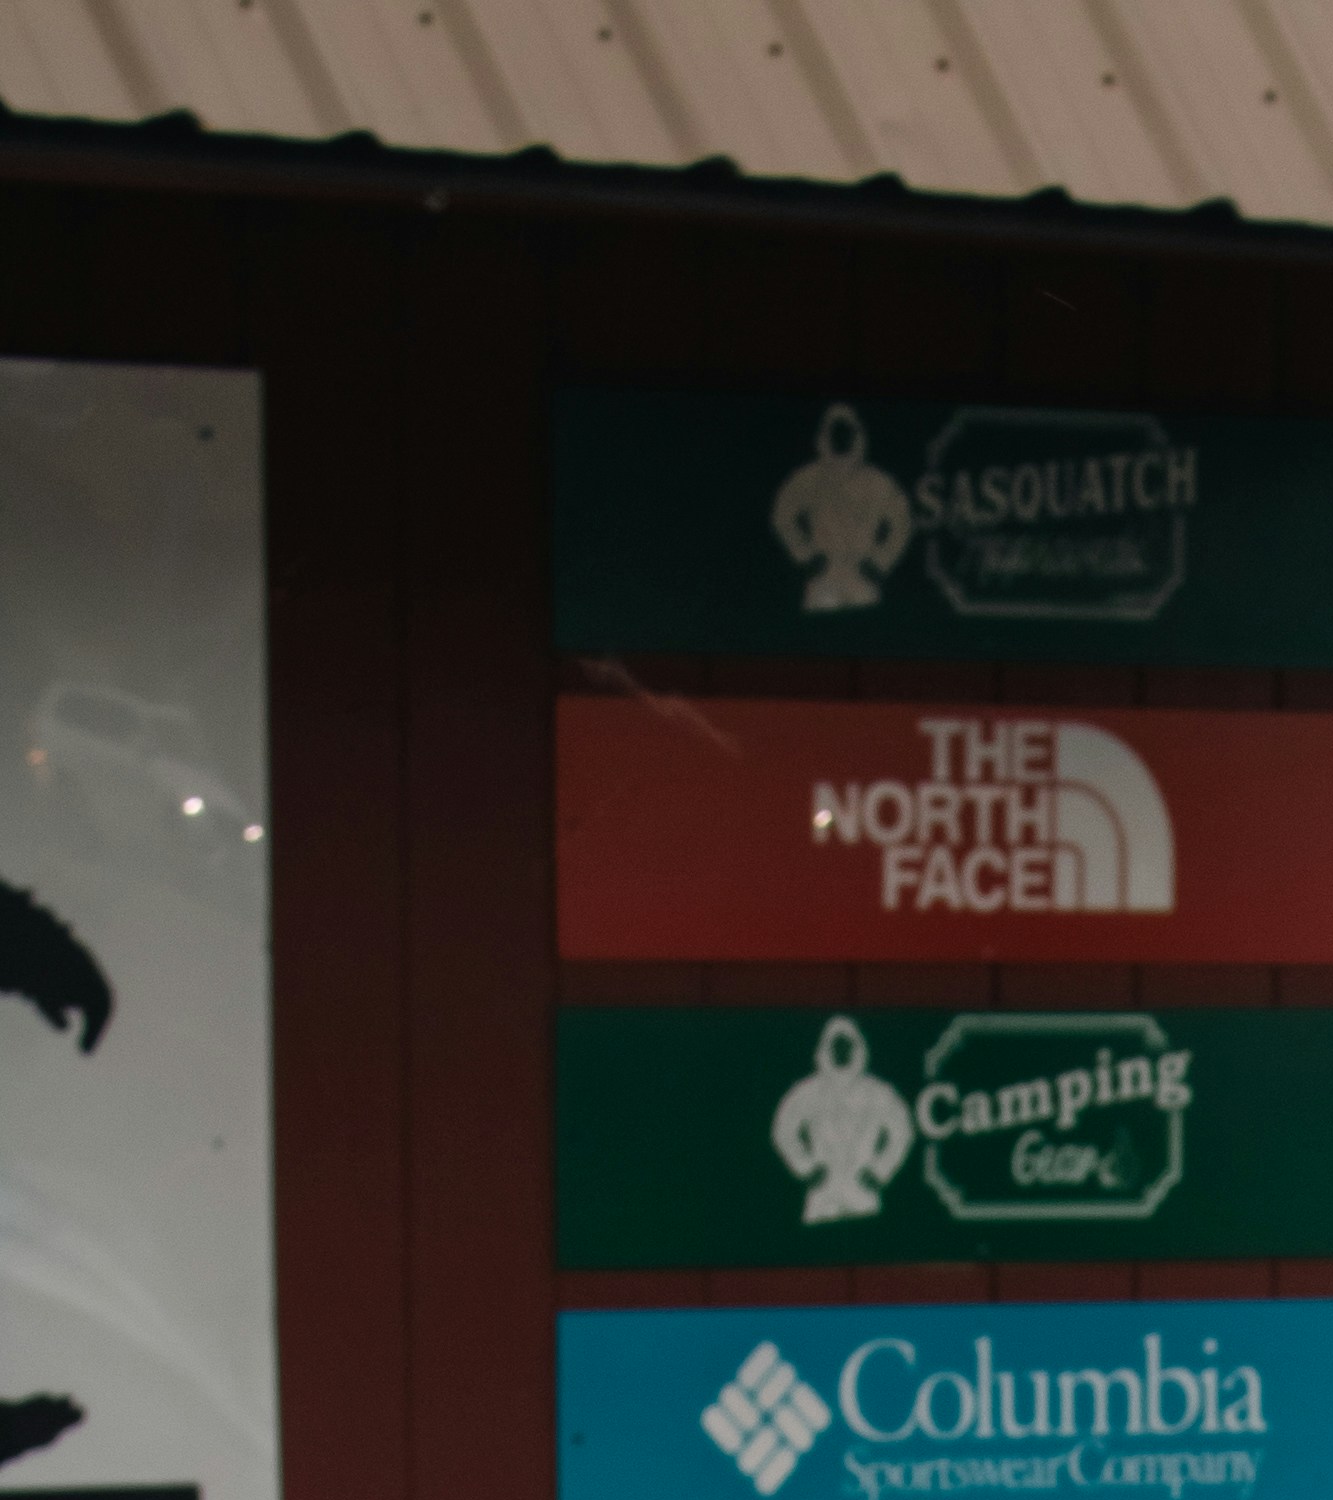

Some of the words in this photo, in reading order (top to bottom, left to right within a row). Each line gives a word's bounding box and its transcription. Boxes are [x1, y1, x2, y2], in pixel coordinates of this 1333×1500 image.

[913, 449, 1196, 529] SASQUATCH
[918, 718, 1054, 784] THE
[811, 781, 1054, 846] NORTH
[882, 847, 1052, 911] FACE
[915, 1047, 1193, 1140] Camping
[838, 1332, 1267, 1443] Columbia
[1066, 1438, 1261, 1500] Company
